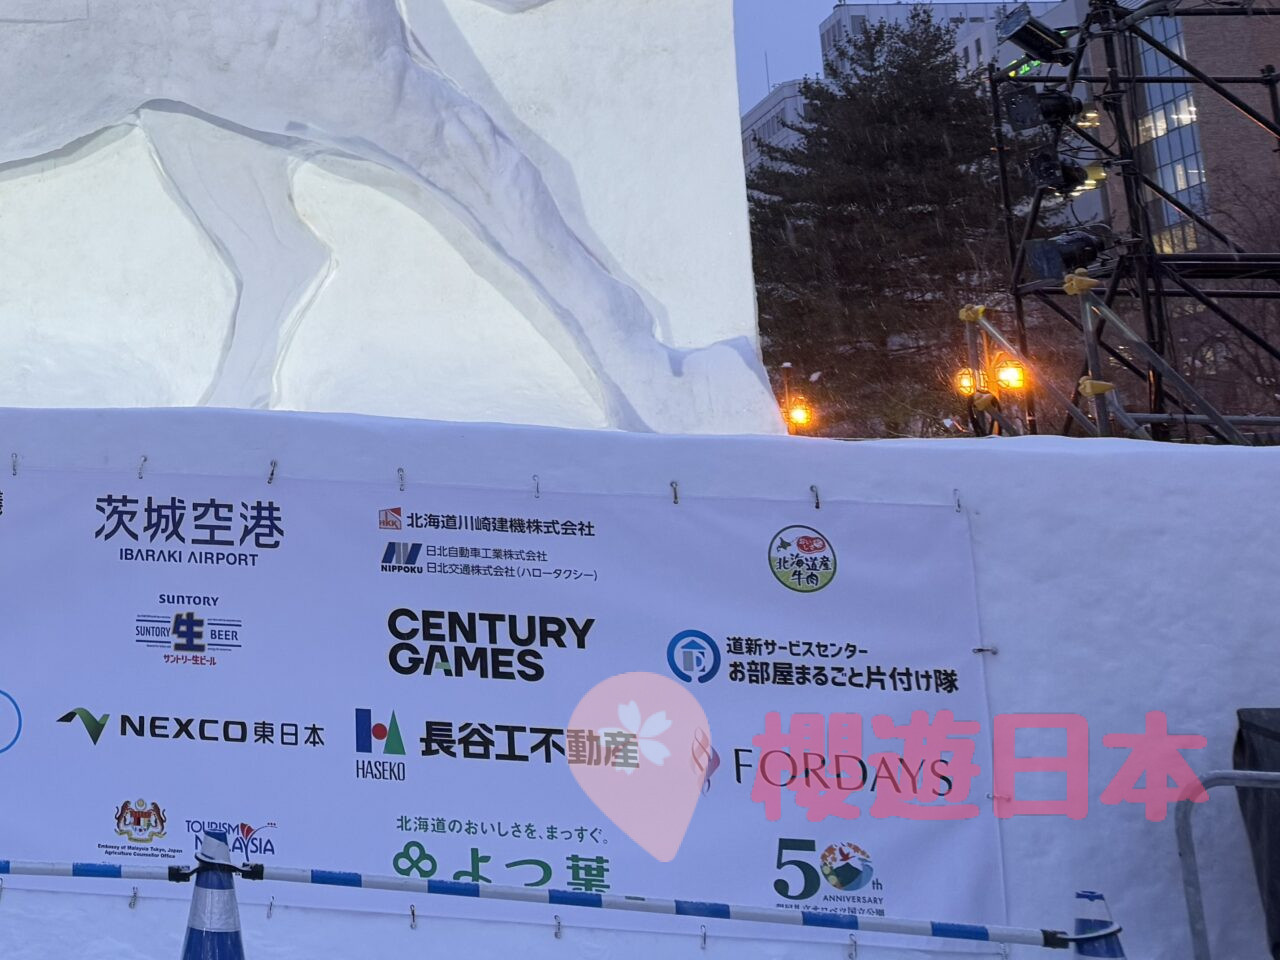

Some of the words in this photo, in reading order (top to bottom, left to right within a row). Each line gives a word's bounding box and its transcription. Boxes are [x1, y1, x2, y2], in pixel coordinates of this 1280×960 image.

[94, 494, 284, 549] 茨城空港
[407, 513, 595, 537] 北海道川崎建機株式会社
[119, 548, 183, 564] IBARAKI
[187, 550, 259, 567] AIRPORT
[426, 545, 548, 562] 日北自動車工業株式会社
[776, 553, 832, 571] 北海道産
[381, 565, 423, 574] NIPPOKU
[791, 570, 819, 586] 牛肉
[135, 625, 171, 638] SUNTORY
[172, 612, 205, 652] 生
[210, 629, 239, 641] BEER
[387, 607, 596, 650] CENTURY
[726, 636, 868, 659] 道新サービスセンター
[163, 654, 217, 666] サントリー生ビール
[388, 642, 545, 682] GAMES
[728, 660, 959, 694] お部屋まるごと片付け隊
[420, 721, 640, 768] 長谷工不動産
[355, 760, 406, 781] HASEKO
[733, 748, 953, 797] FORDAYS
[396, 815, 608, 845] 北海道のおいしさを、まっすぐ。
[453, 847, 610, 893] よつ葉
[823, 895, 883, 905] ANNIVERSARY
